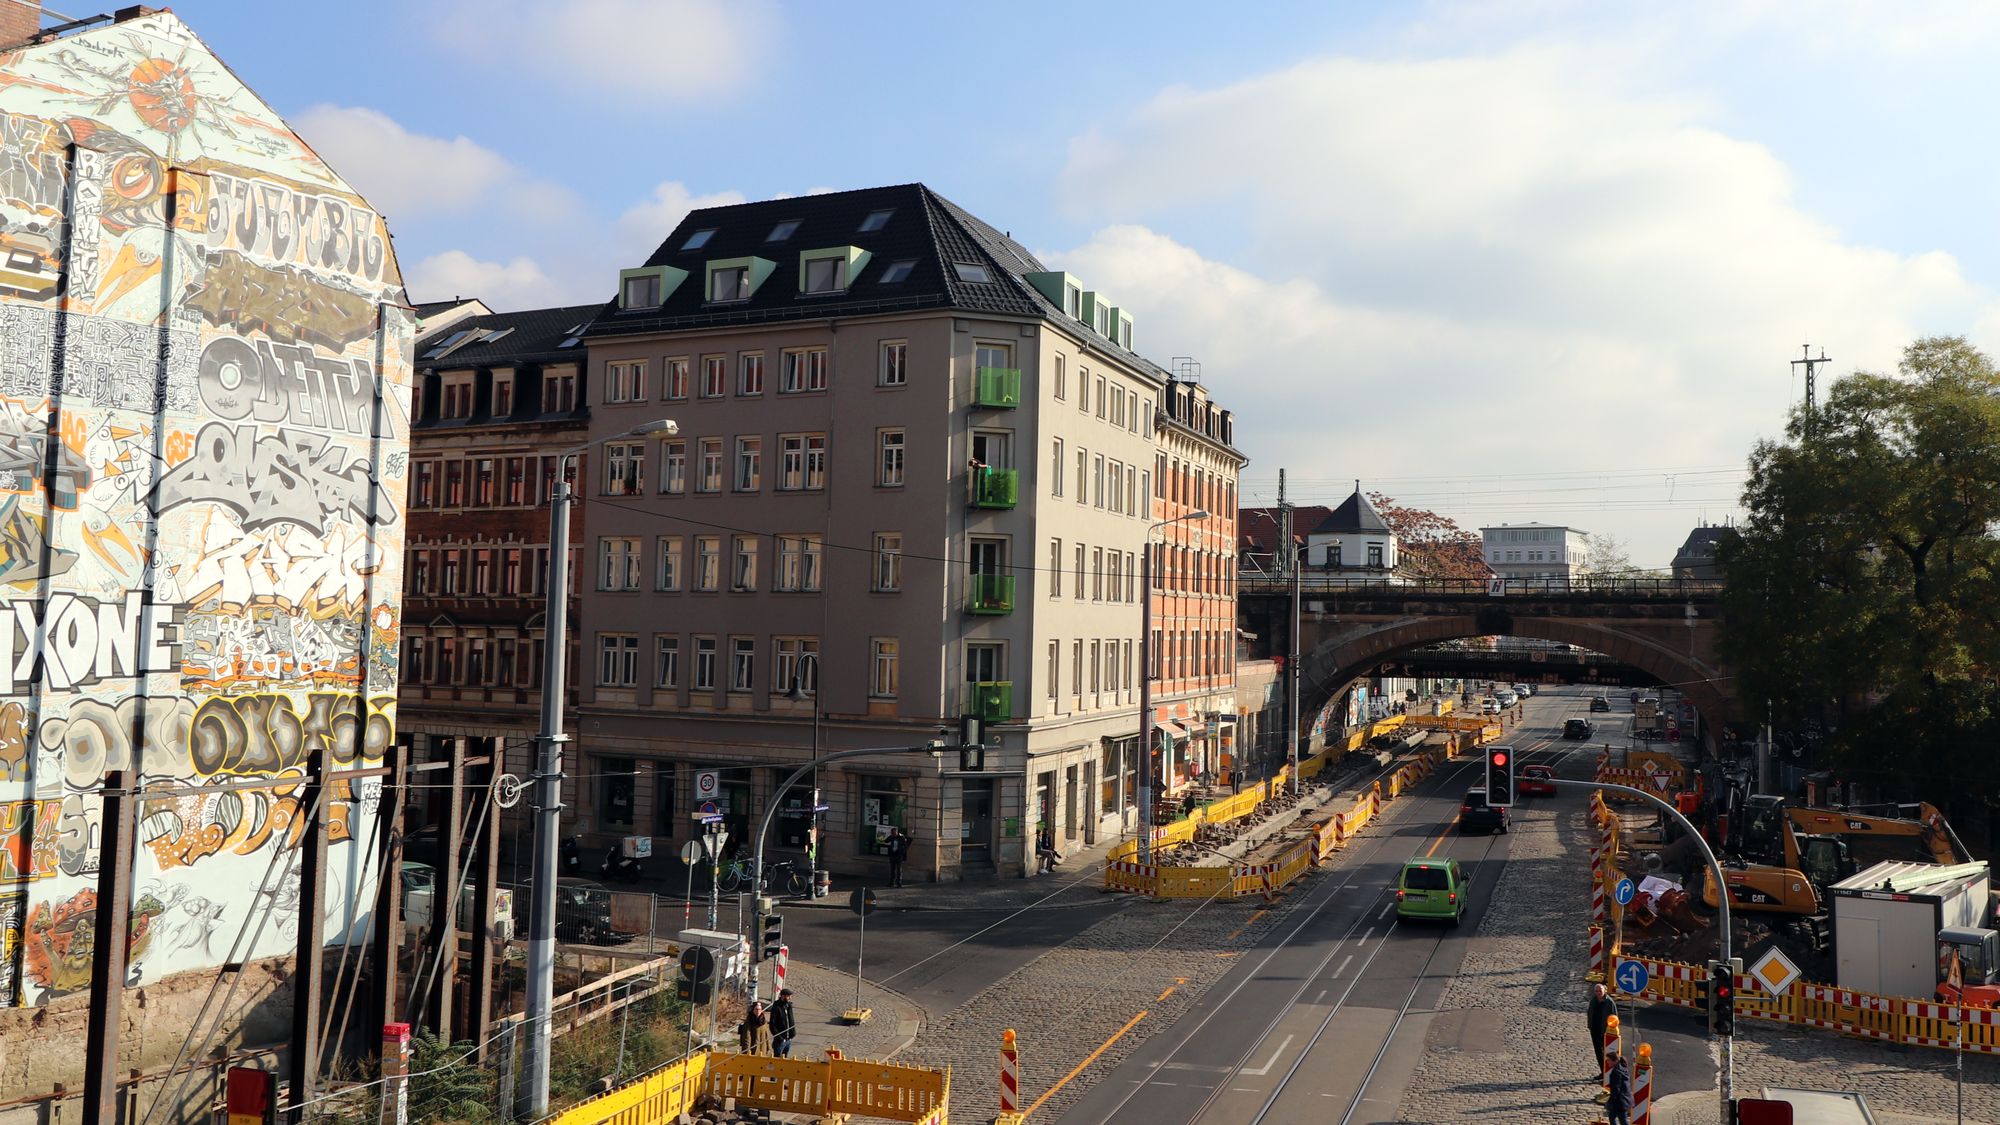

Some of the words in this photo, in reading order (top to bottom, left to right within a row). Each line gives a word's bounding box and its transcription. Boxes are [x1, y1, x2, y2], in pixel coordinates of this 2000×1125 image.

[703, 779, 712, 787] 30
[1850, 822, 1862, 830] CAT
[1752, 894, 1765, 903] CAT
